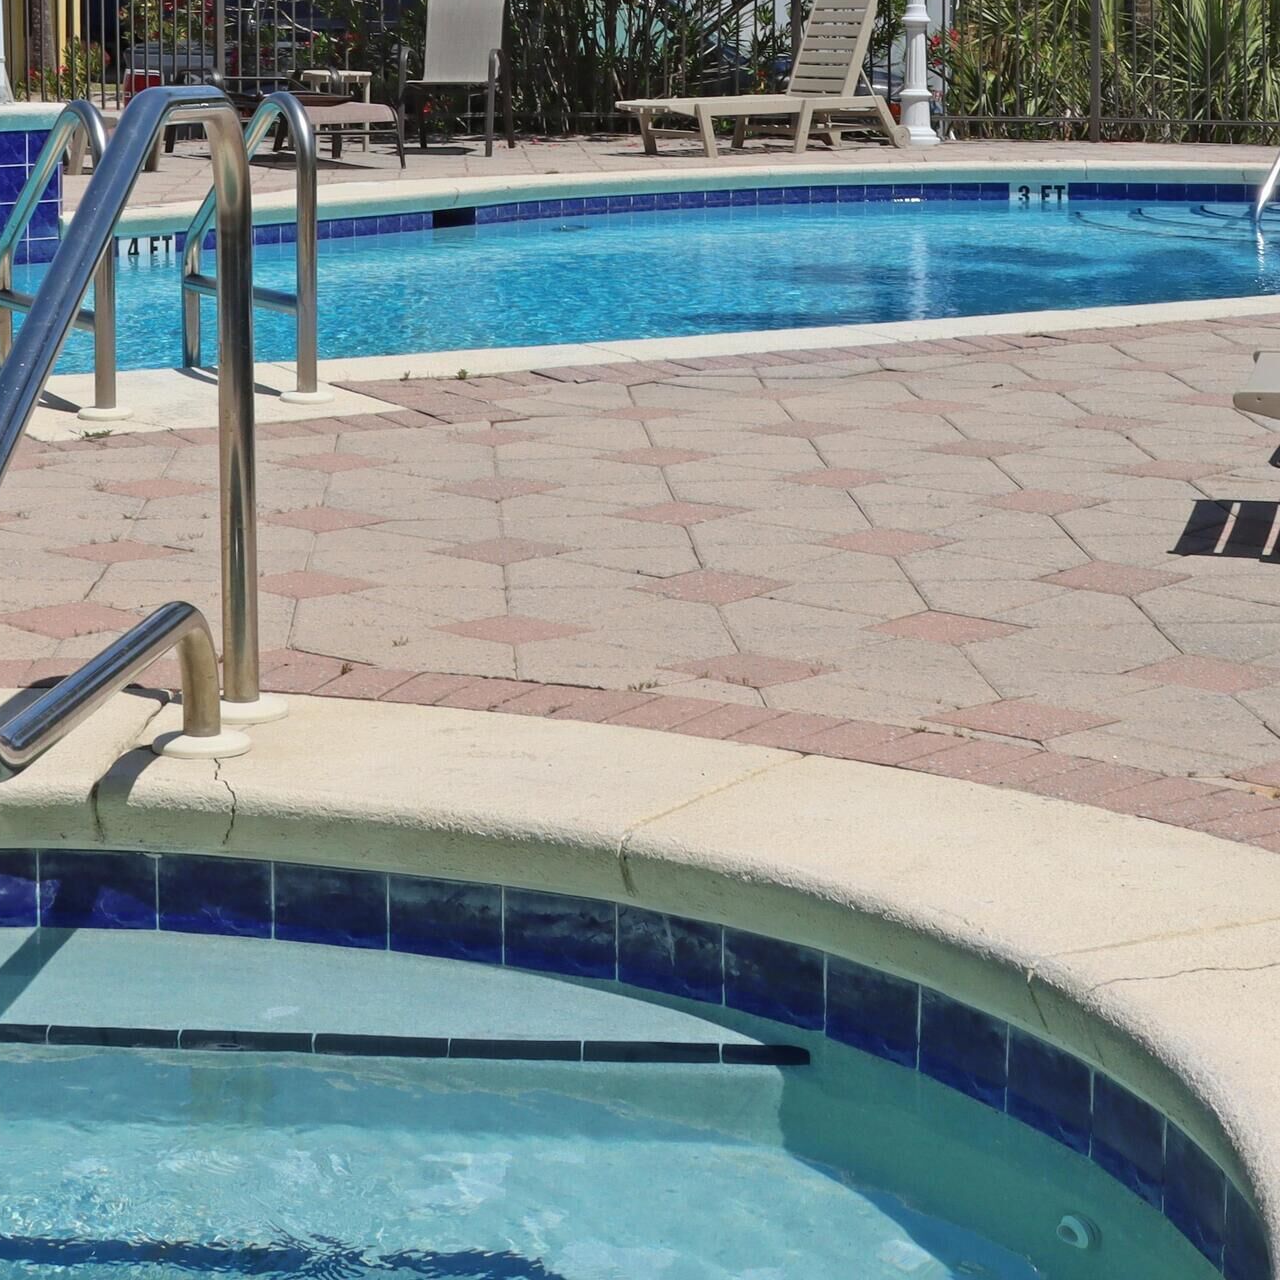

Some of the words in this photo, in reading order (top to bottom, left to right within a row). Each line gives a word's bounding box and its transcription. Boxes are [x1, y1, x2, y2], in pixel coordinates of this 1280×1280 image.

[1018, 185, 1030, 201] 3
[1041, 185, 1066, 201] FT
[128, 237, 140, 256] 4
[150, 236, 173, 255] FT
